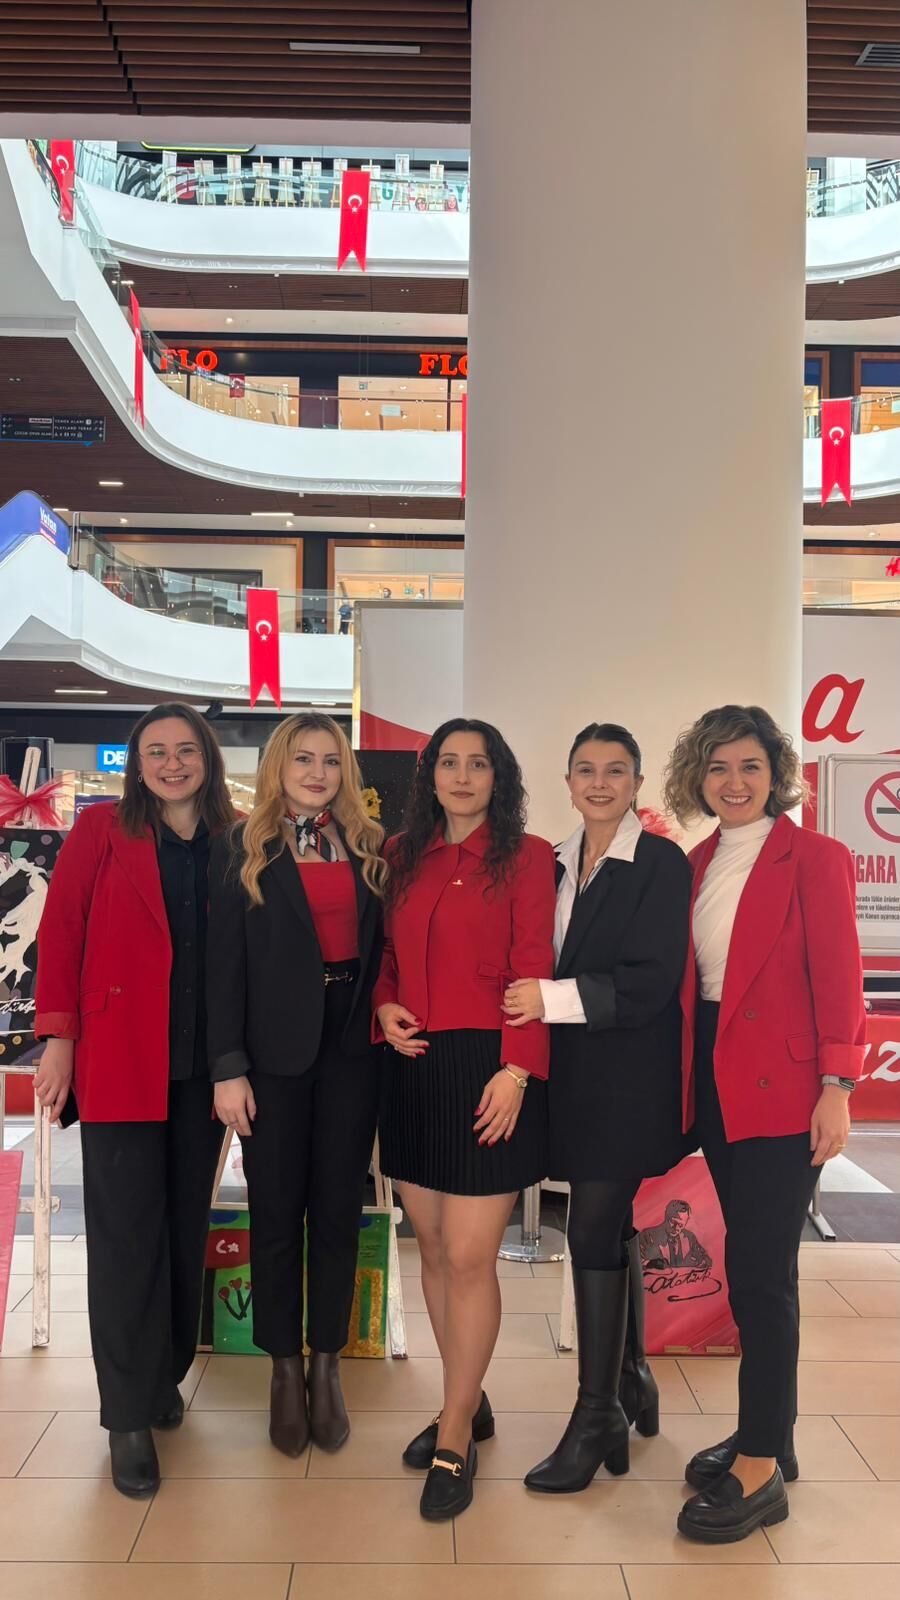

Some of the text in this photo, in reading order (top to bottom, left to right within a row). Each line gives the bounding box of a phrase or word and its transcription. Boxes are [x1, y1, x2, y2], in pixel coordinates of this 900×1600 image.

[159, 348, 218, 372] FLO
[39, 506, 57, 533] Vatan
[802, 673, 865, 743] a
[103, 750, 128, 766] DE
